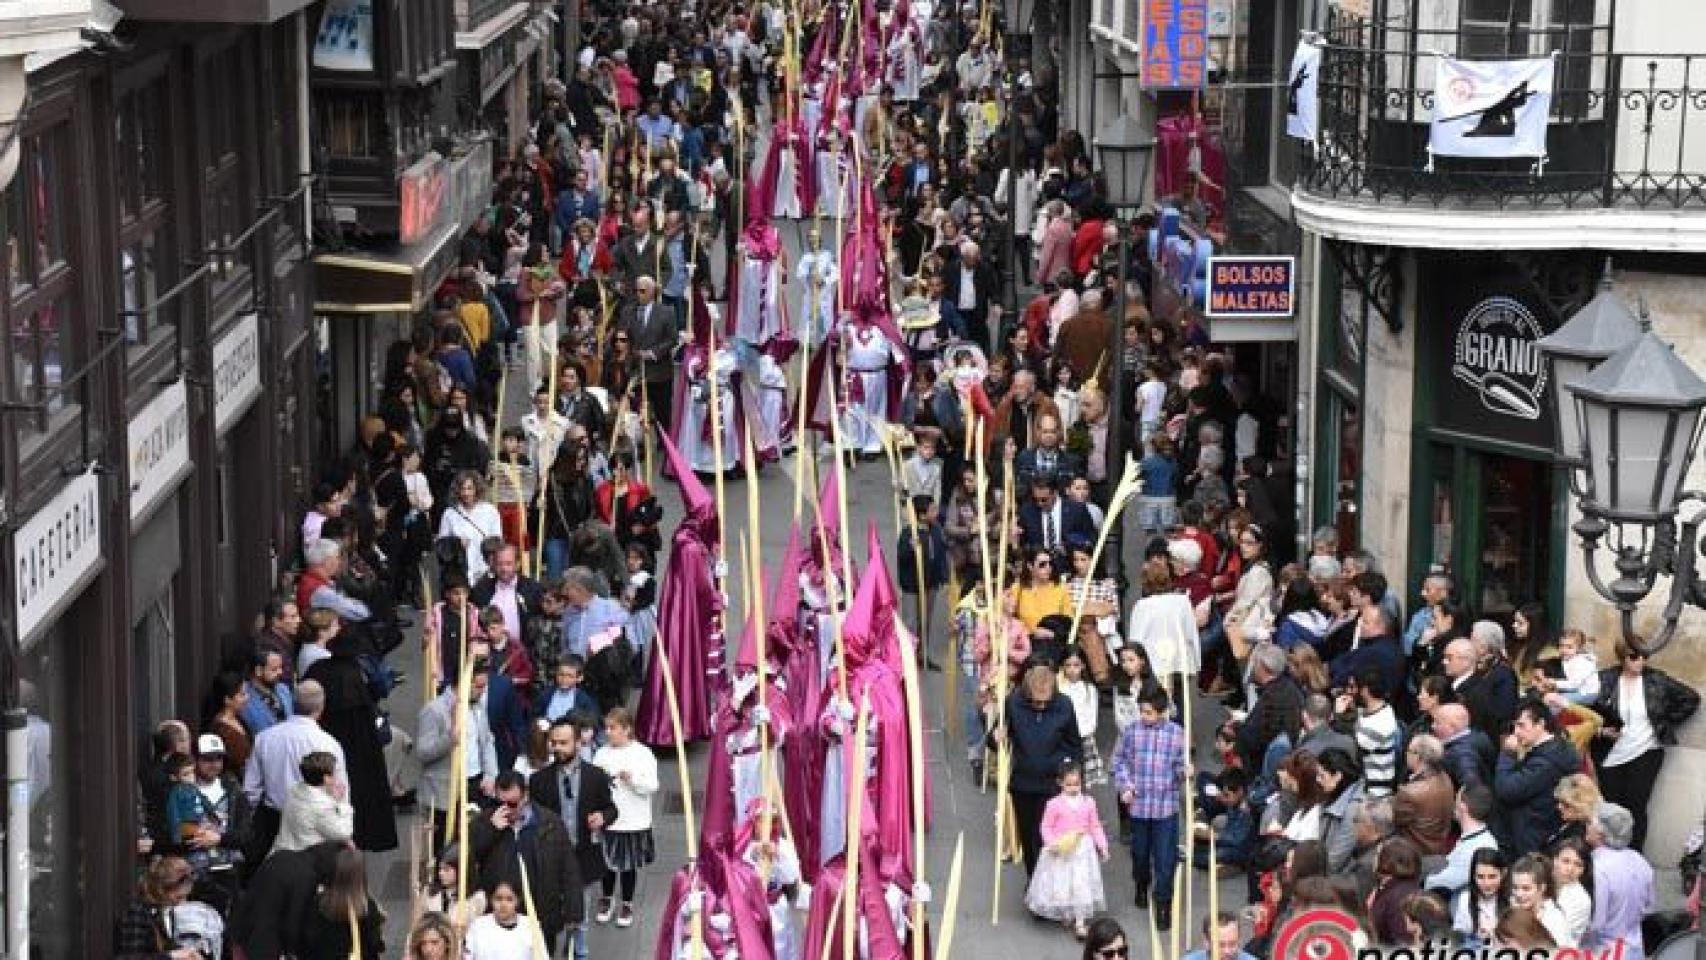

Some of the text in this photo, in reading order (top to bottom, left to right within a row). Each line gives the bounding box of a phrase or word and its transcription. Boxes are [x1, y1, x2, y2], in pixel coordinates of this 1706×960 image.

[1216, 265, 1286, 285] BOLSOS
[1212, 291, 1290, 310] MALETAS
[19, 487, 96, 608] CAFETERIA
